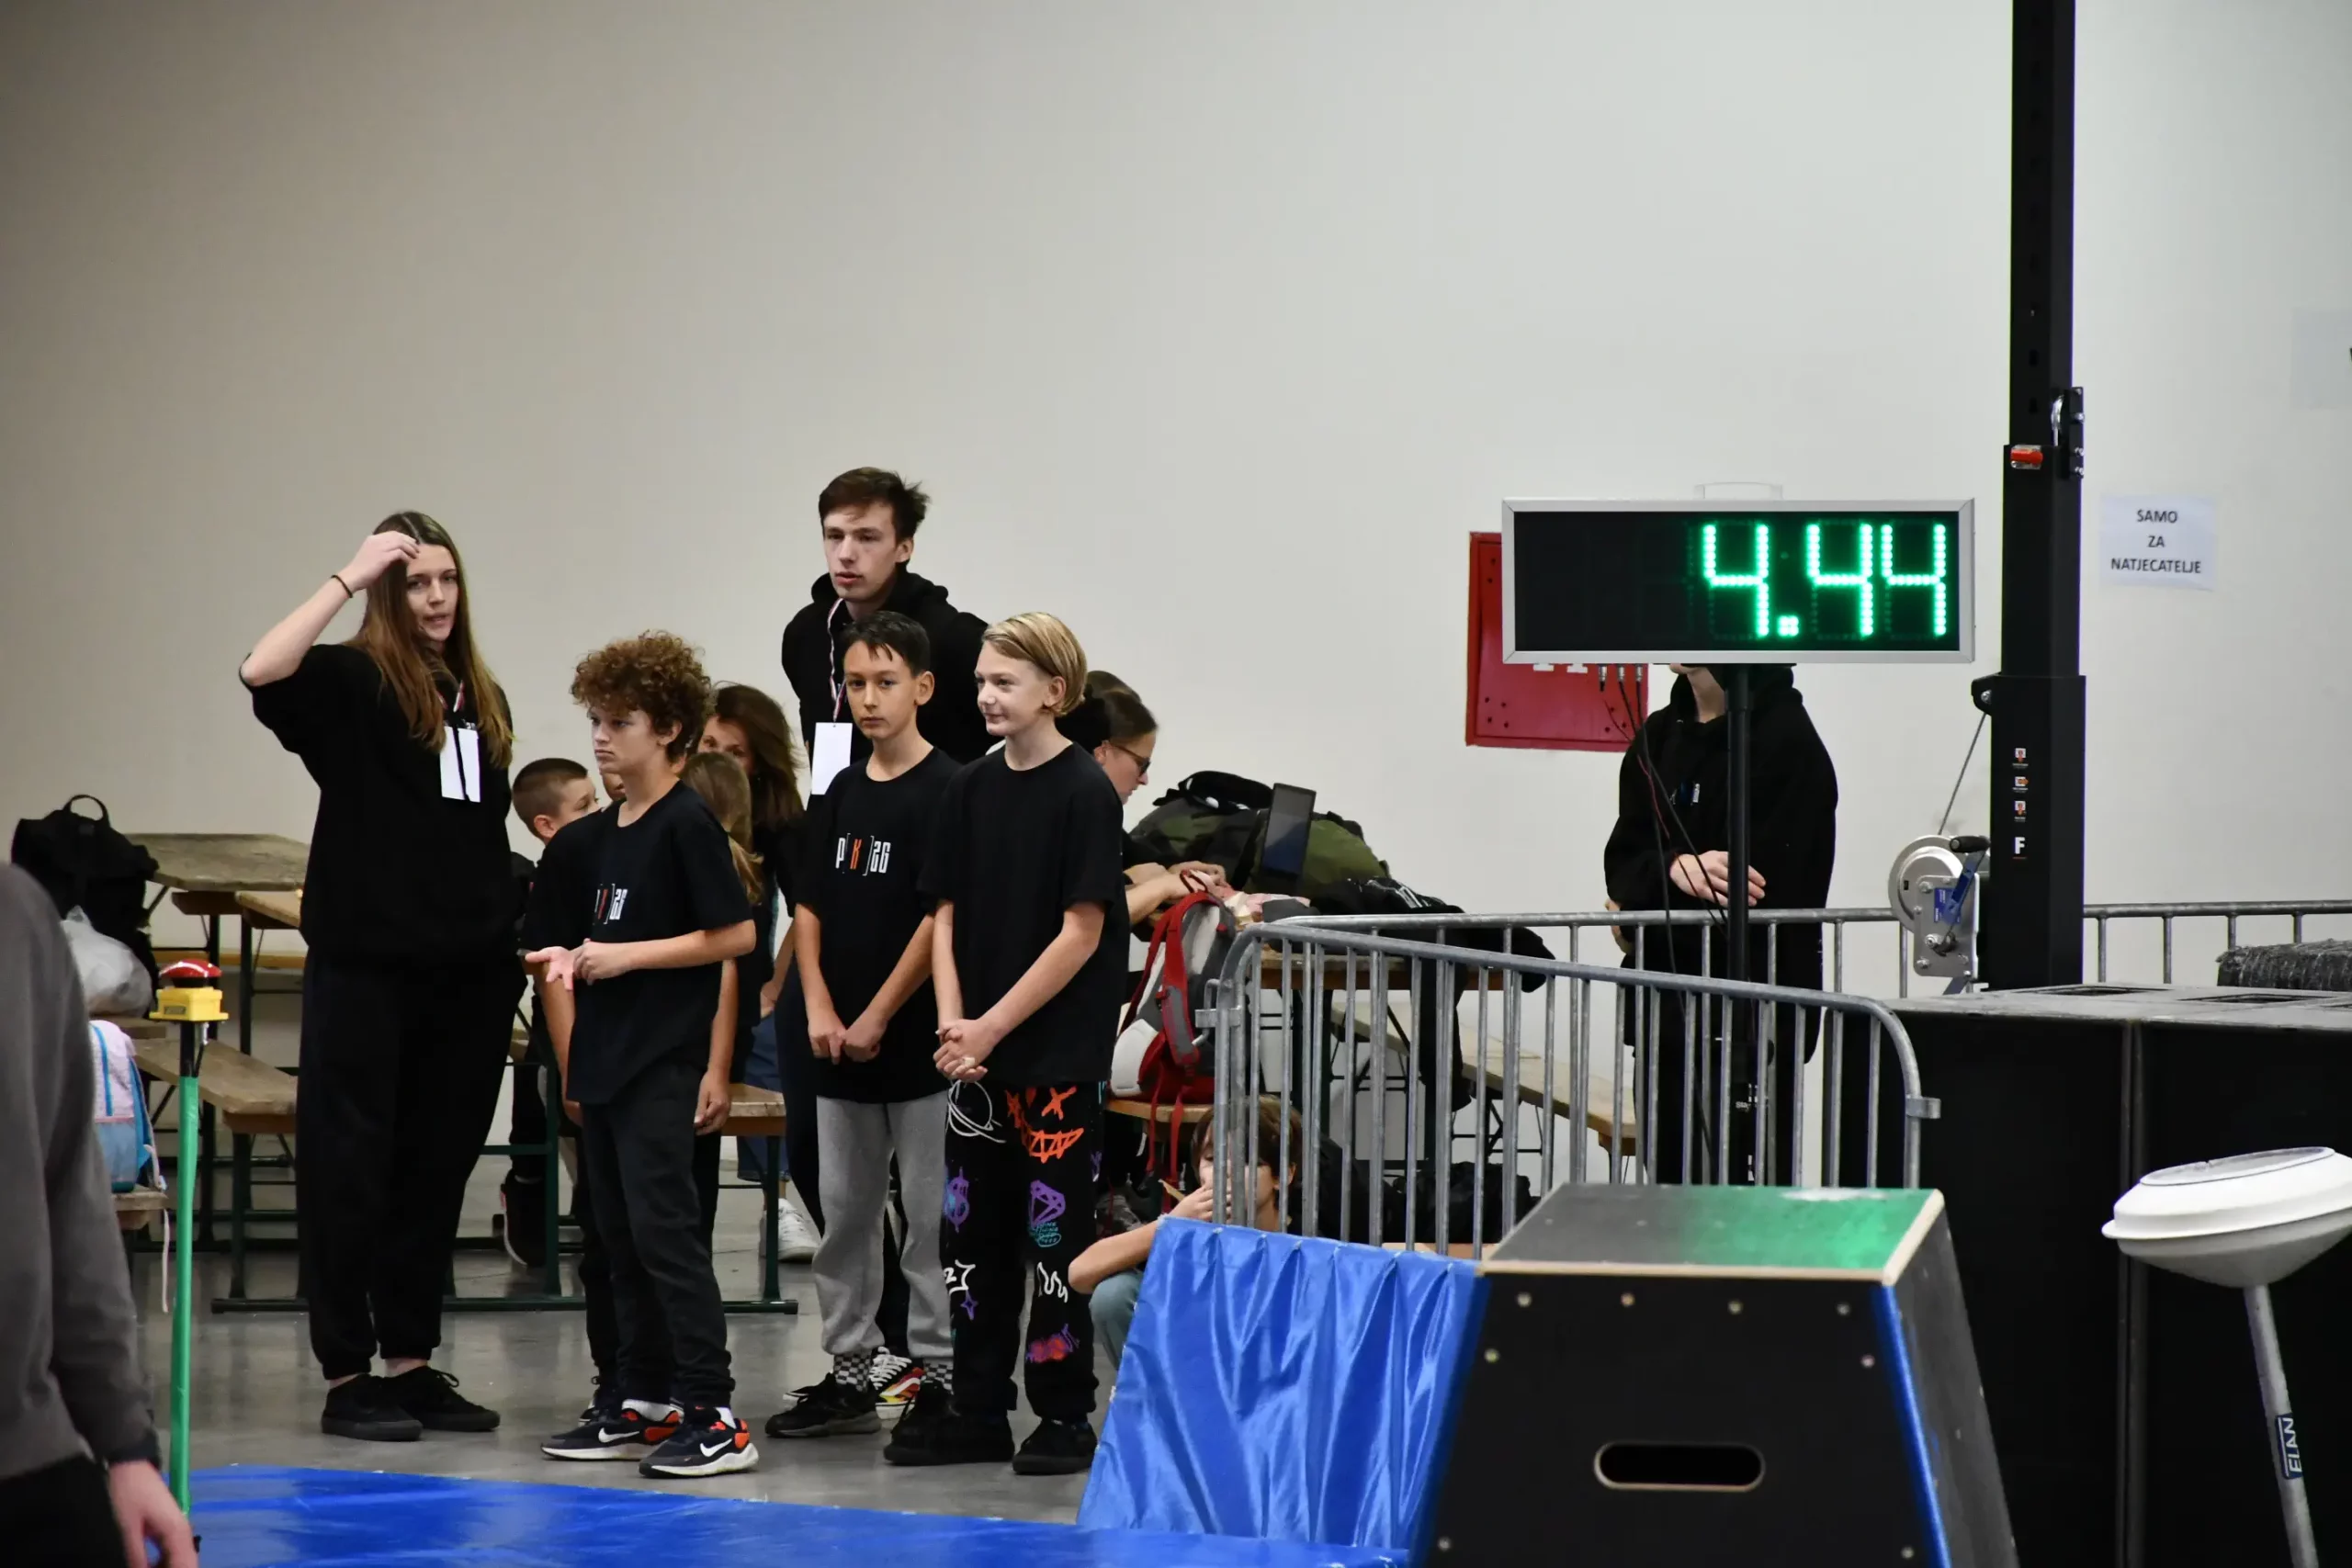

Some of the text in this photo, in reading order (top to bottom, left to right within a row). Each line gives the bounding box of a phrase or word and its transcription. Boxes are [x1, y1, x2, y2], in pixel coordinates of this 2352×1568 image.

[2137, 509, 2178, 524] SAMO
[2147, 536, 2165, 548] ZA
[2110, 558, 2202, 574] NATJECATELJE
[1702, 523, 1947, 637] 4.44
[2282, 1417, 2302, 1472] ELAN
